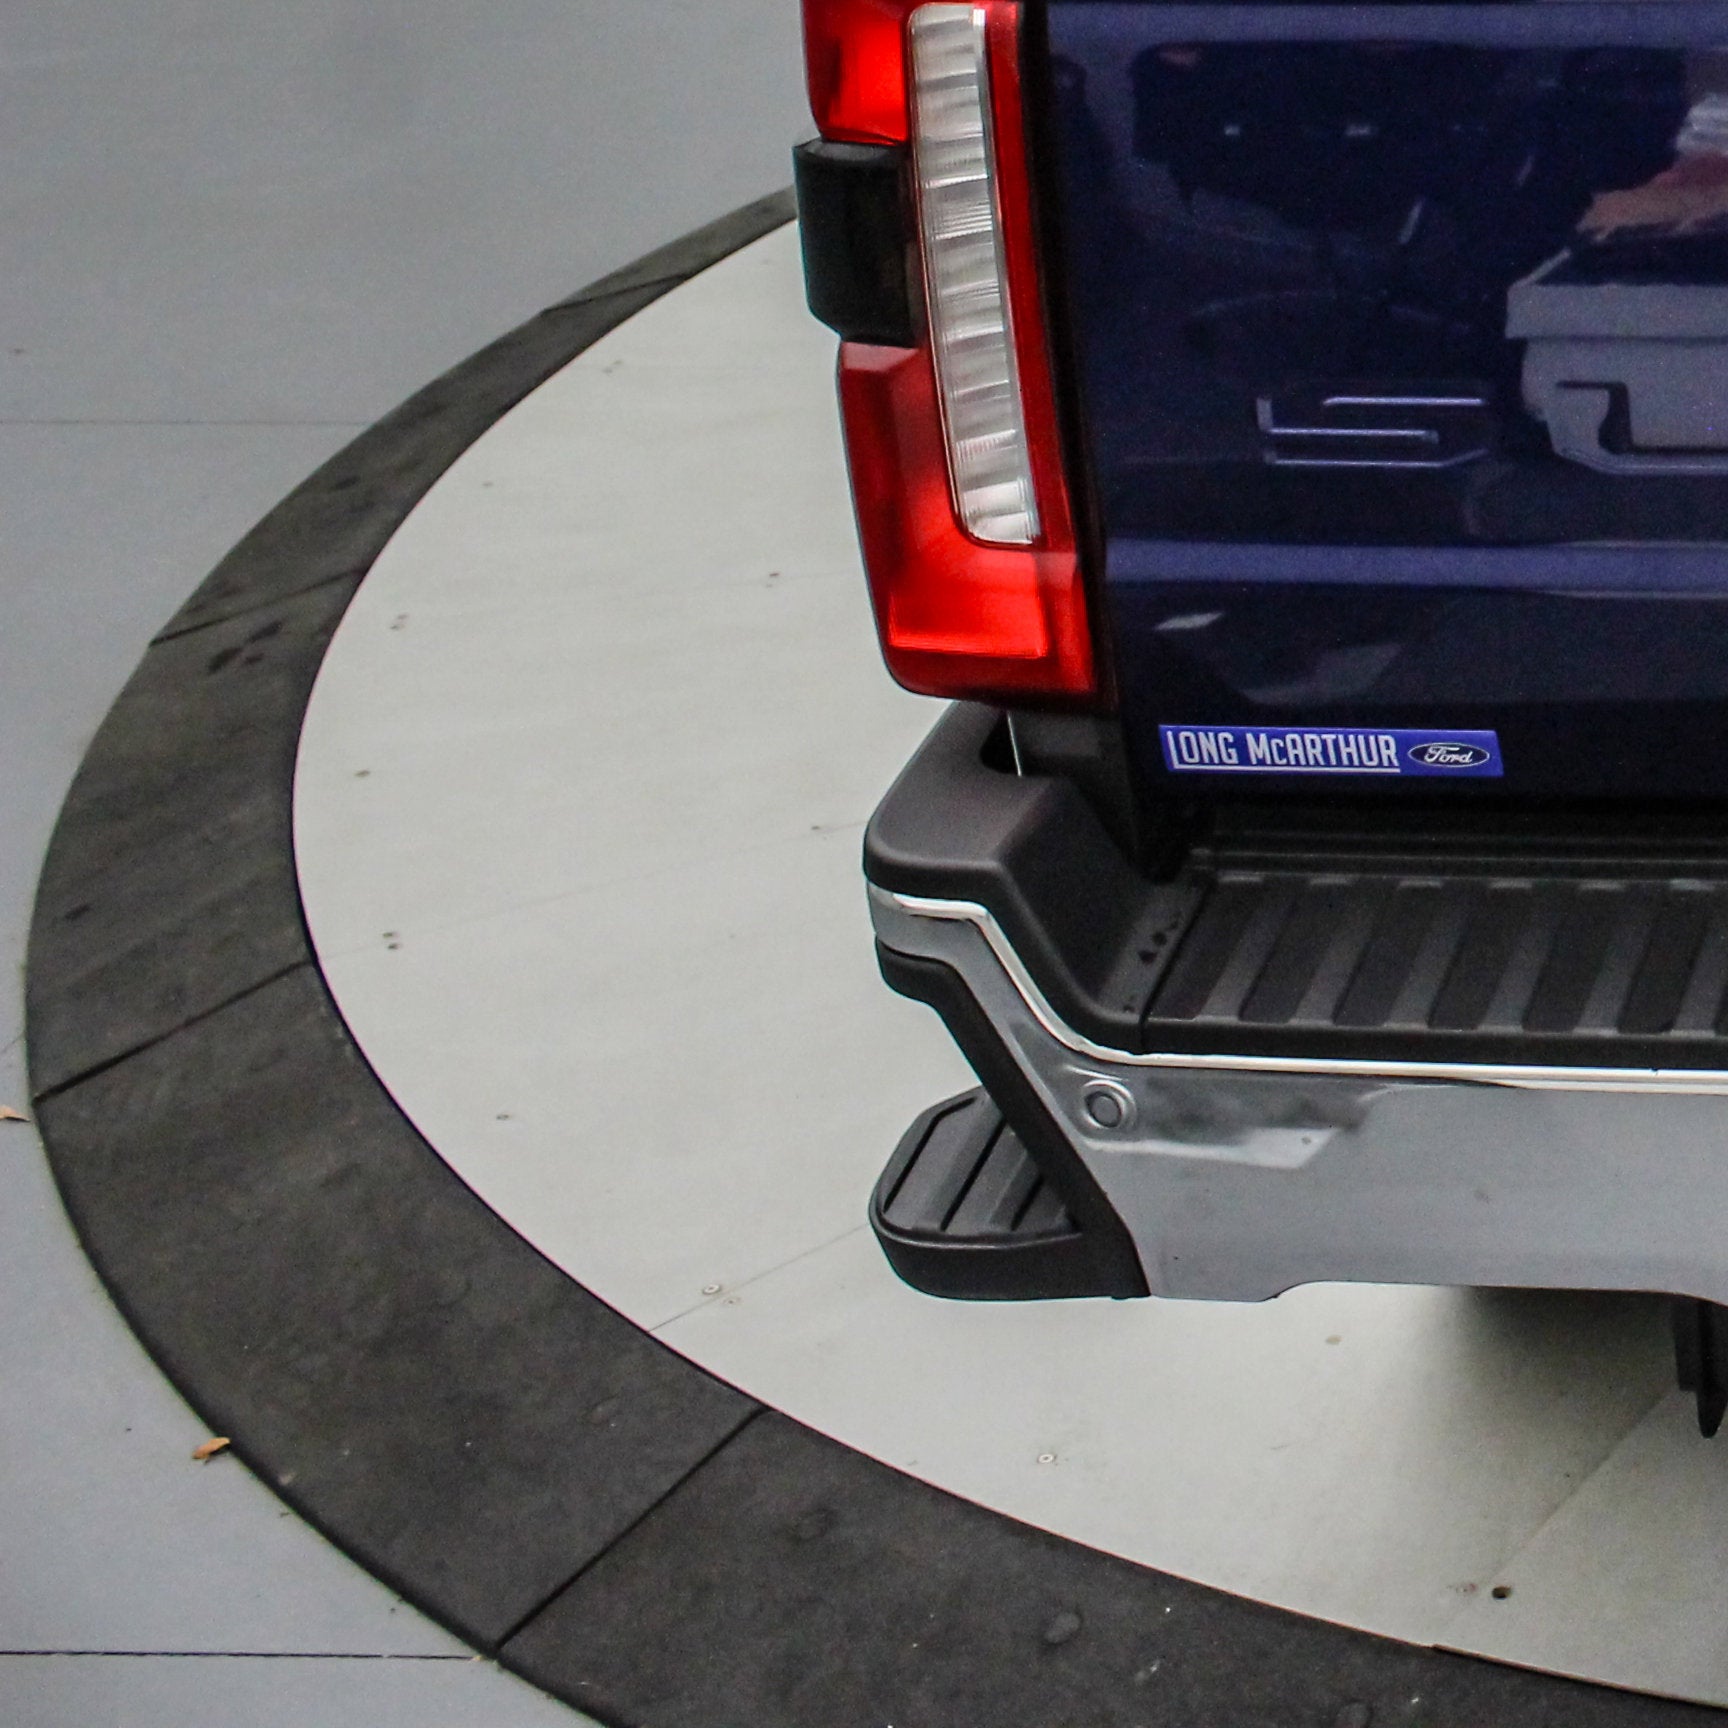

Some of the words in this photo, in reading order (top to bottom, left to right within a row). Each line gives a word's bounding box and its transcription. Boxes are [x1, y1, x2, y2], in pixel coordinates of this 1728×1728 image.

[1166, 729, 1239, 769] LONG
[1247, 732, 1399, 766] McARTHUR
[1423, 745, 1473, 765] Ford
